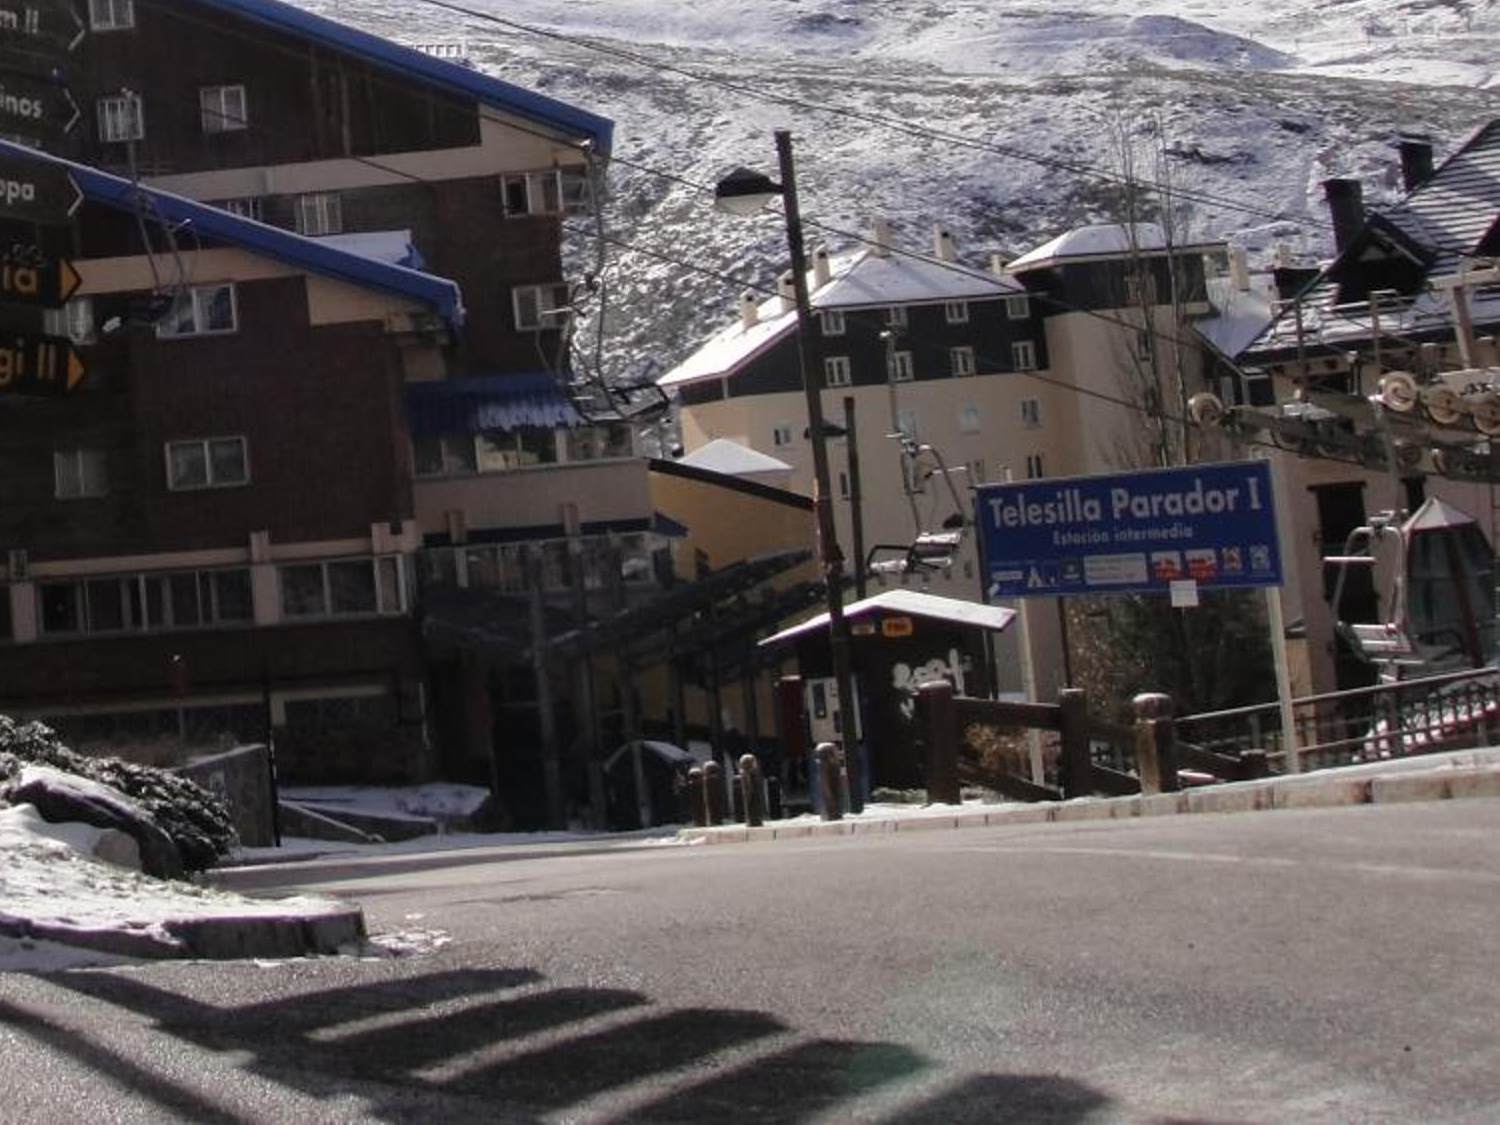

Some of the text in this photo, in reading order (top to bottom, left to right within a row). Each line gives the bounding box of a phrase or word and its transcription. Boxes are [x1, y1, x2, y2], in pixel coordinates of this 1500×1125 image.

[36, 343, 56, 380] II
[988, 476, 1262, 528] Telesilla Parador I
